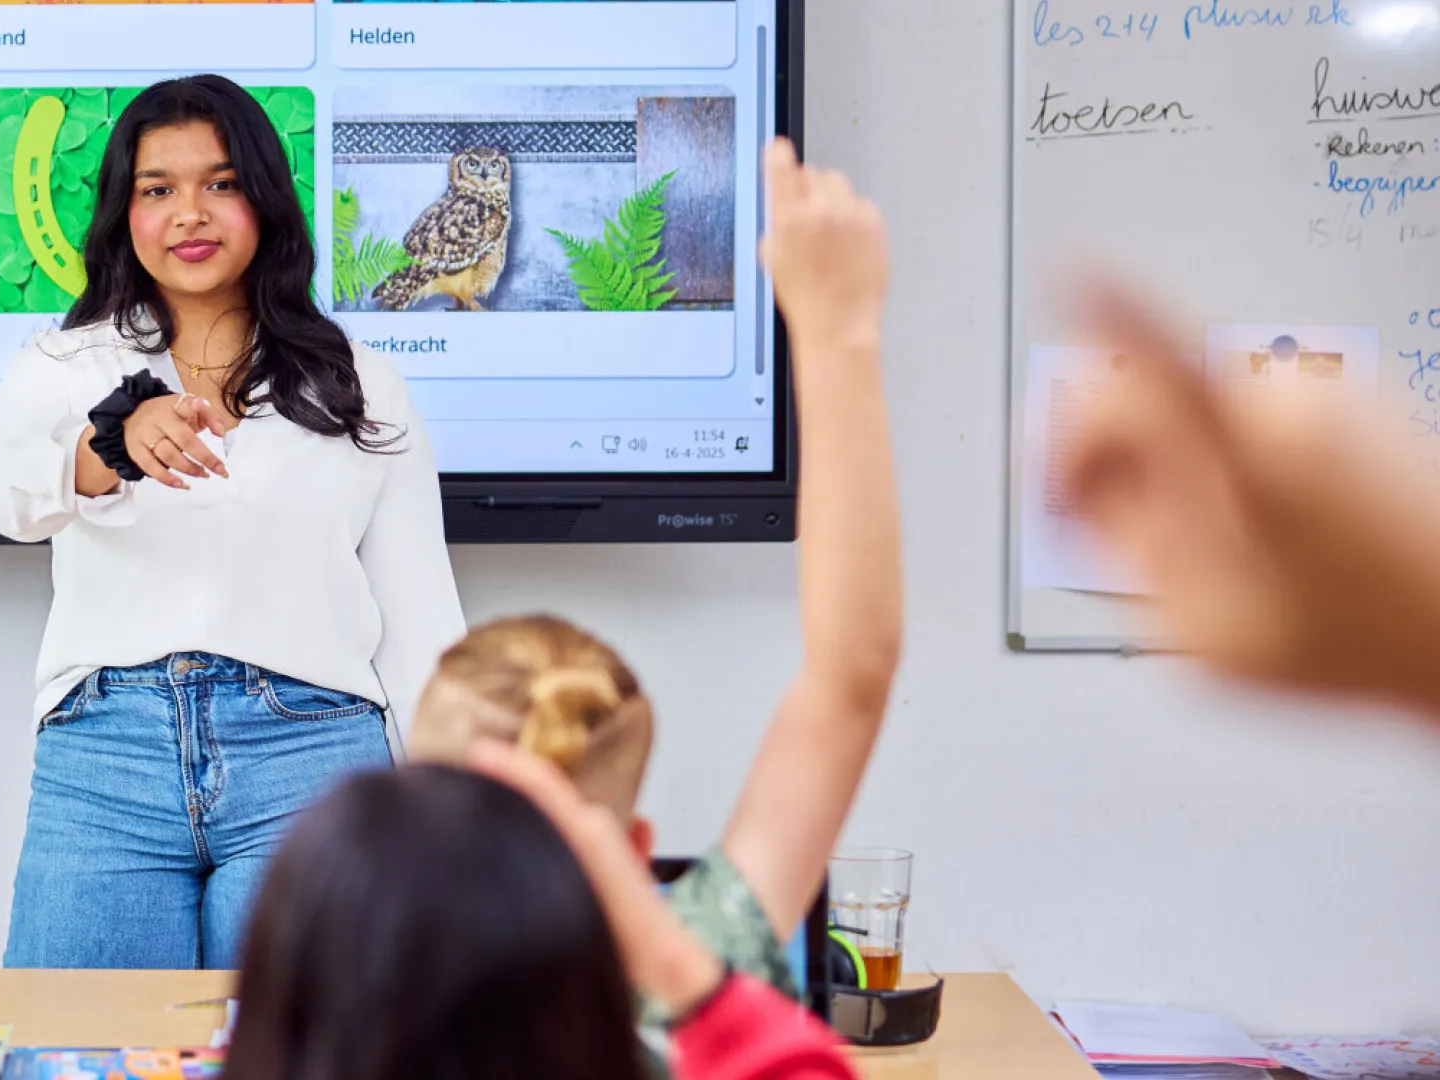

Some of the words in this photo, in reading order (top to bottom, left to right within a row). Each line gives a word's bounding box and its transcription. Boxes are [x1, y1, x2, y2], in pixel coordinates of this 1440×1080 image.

[1034, 0, 1084, 46] les
[1095, 13, 1158, 42] 2+4
[350, 27, 416, 45] Helden
[1030, 83, 1194, 134] toetsen
[1328, 127, 1424, 157] Rekenen
[350, 335, 448, 353] eerkracht
[664, 447, 726, 460] 16-4-2025
